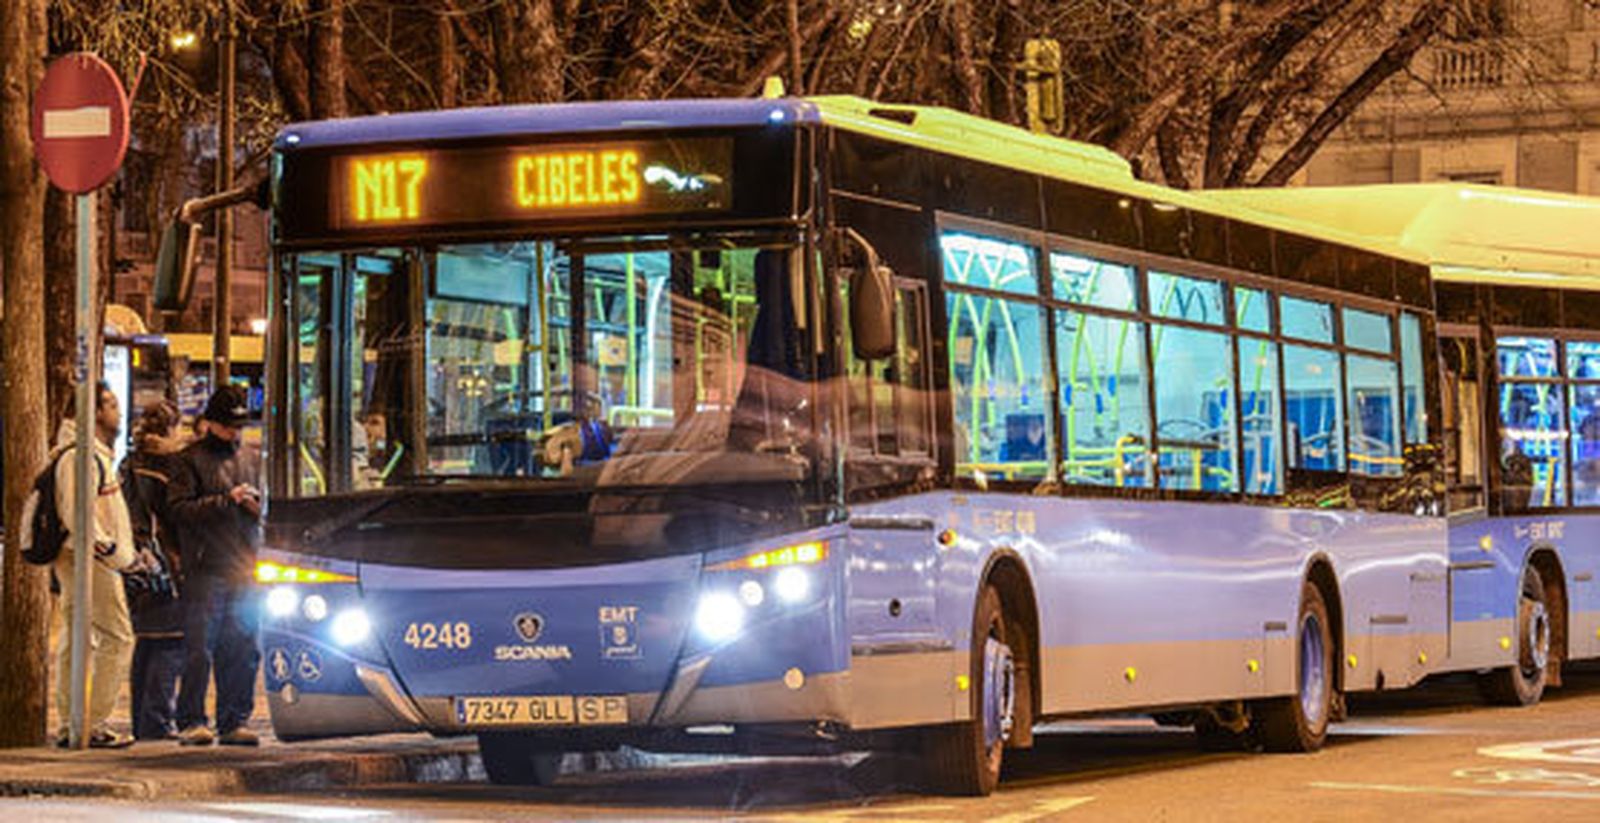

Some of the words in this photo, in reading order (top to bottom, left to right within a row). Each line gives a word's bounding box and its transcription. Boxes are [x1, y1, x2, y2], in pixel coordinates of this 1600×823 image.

[351, 153, 428, 221] N17
[512, 150, 640, 209] CIBELES
[599, 606, 639, 623] EMT
[403, 622, 472, 650] 4248
[494, 645, 573, 661] SCANIA
[467, 701, 518, 721] 7347
[528, 700, 568, 721] GLL
